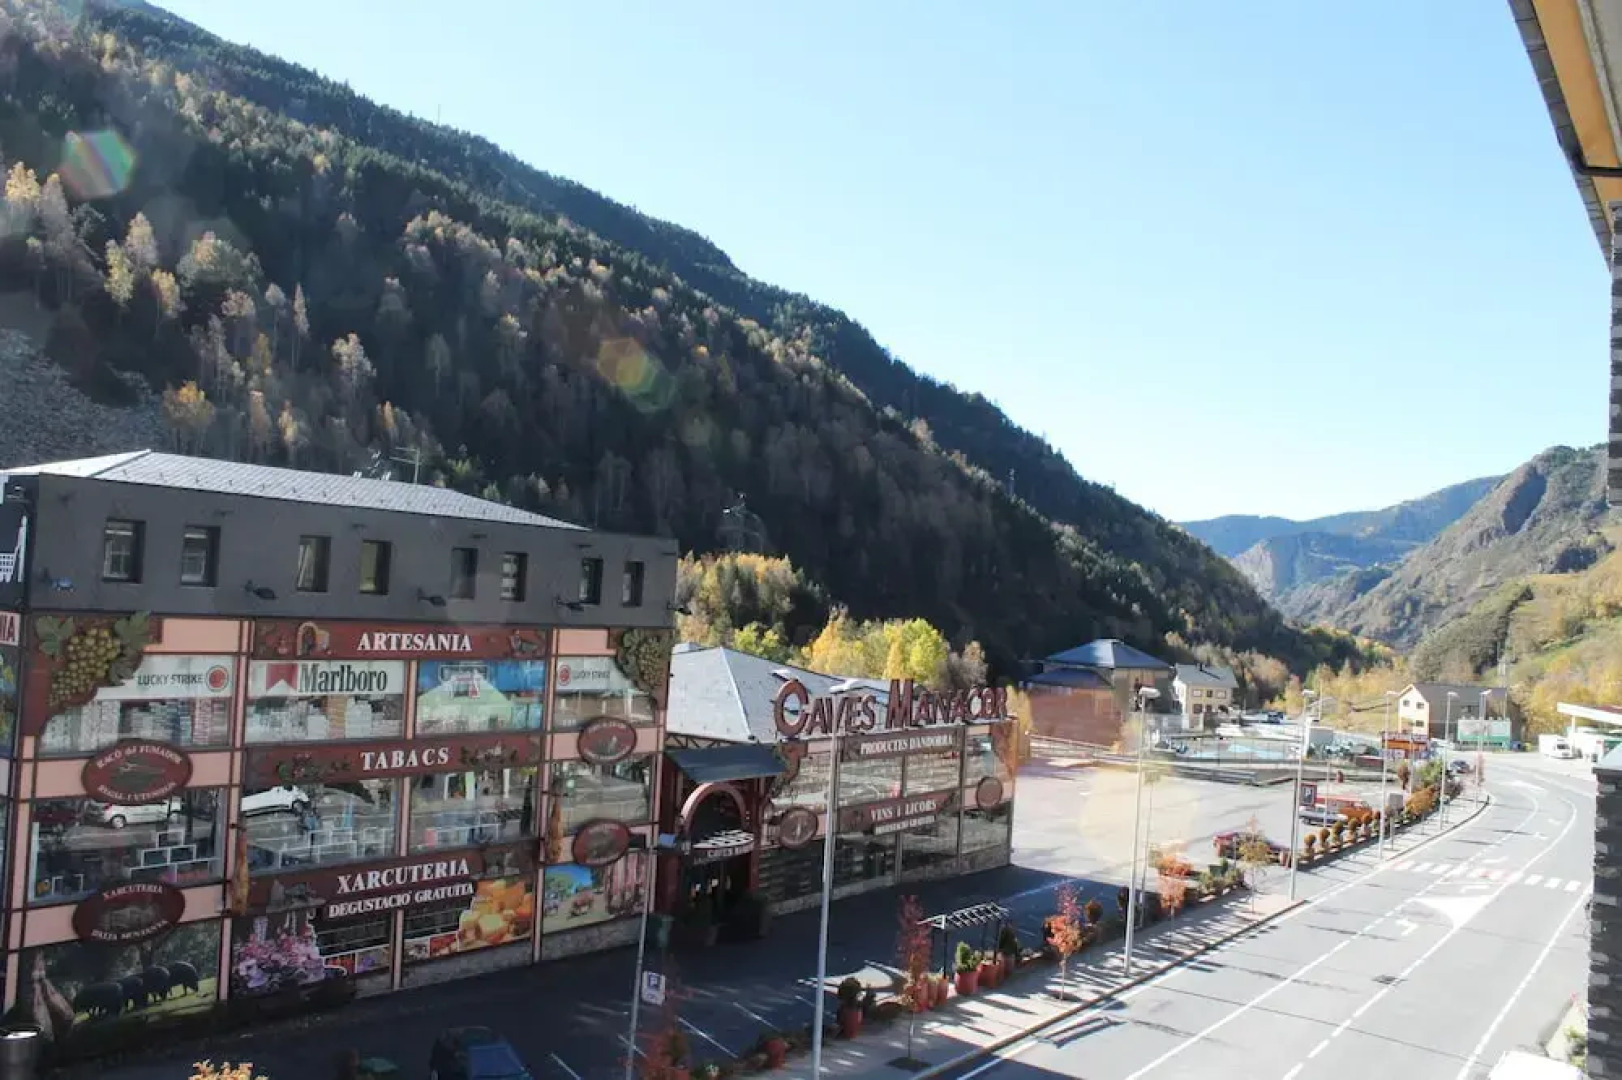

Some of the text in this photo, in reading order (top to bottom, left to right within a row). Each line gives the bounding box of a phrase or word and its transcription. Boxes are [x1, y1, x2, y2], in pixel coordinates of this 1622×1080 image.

[356, 632, 472, 652] ARTESANIA
[137, 674, 204, 685] LUCKY STRIKE
[299, 663, 388, 692] Marlboro
[361, 747, 449, 771] TABACS
[905, 799, 937, 815] LICORS
[337, 858, 470, 894] XARCUTERIA
[414, 881, 474, 903] GRATUITA
